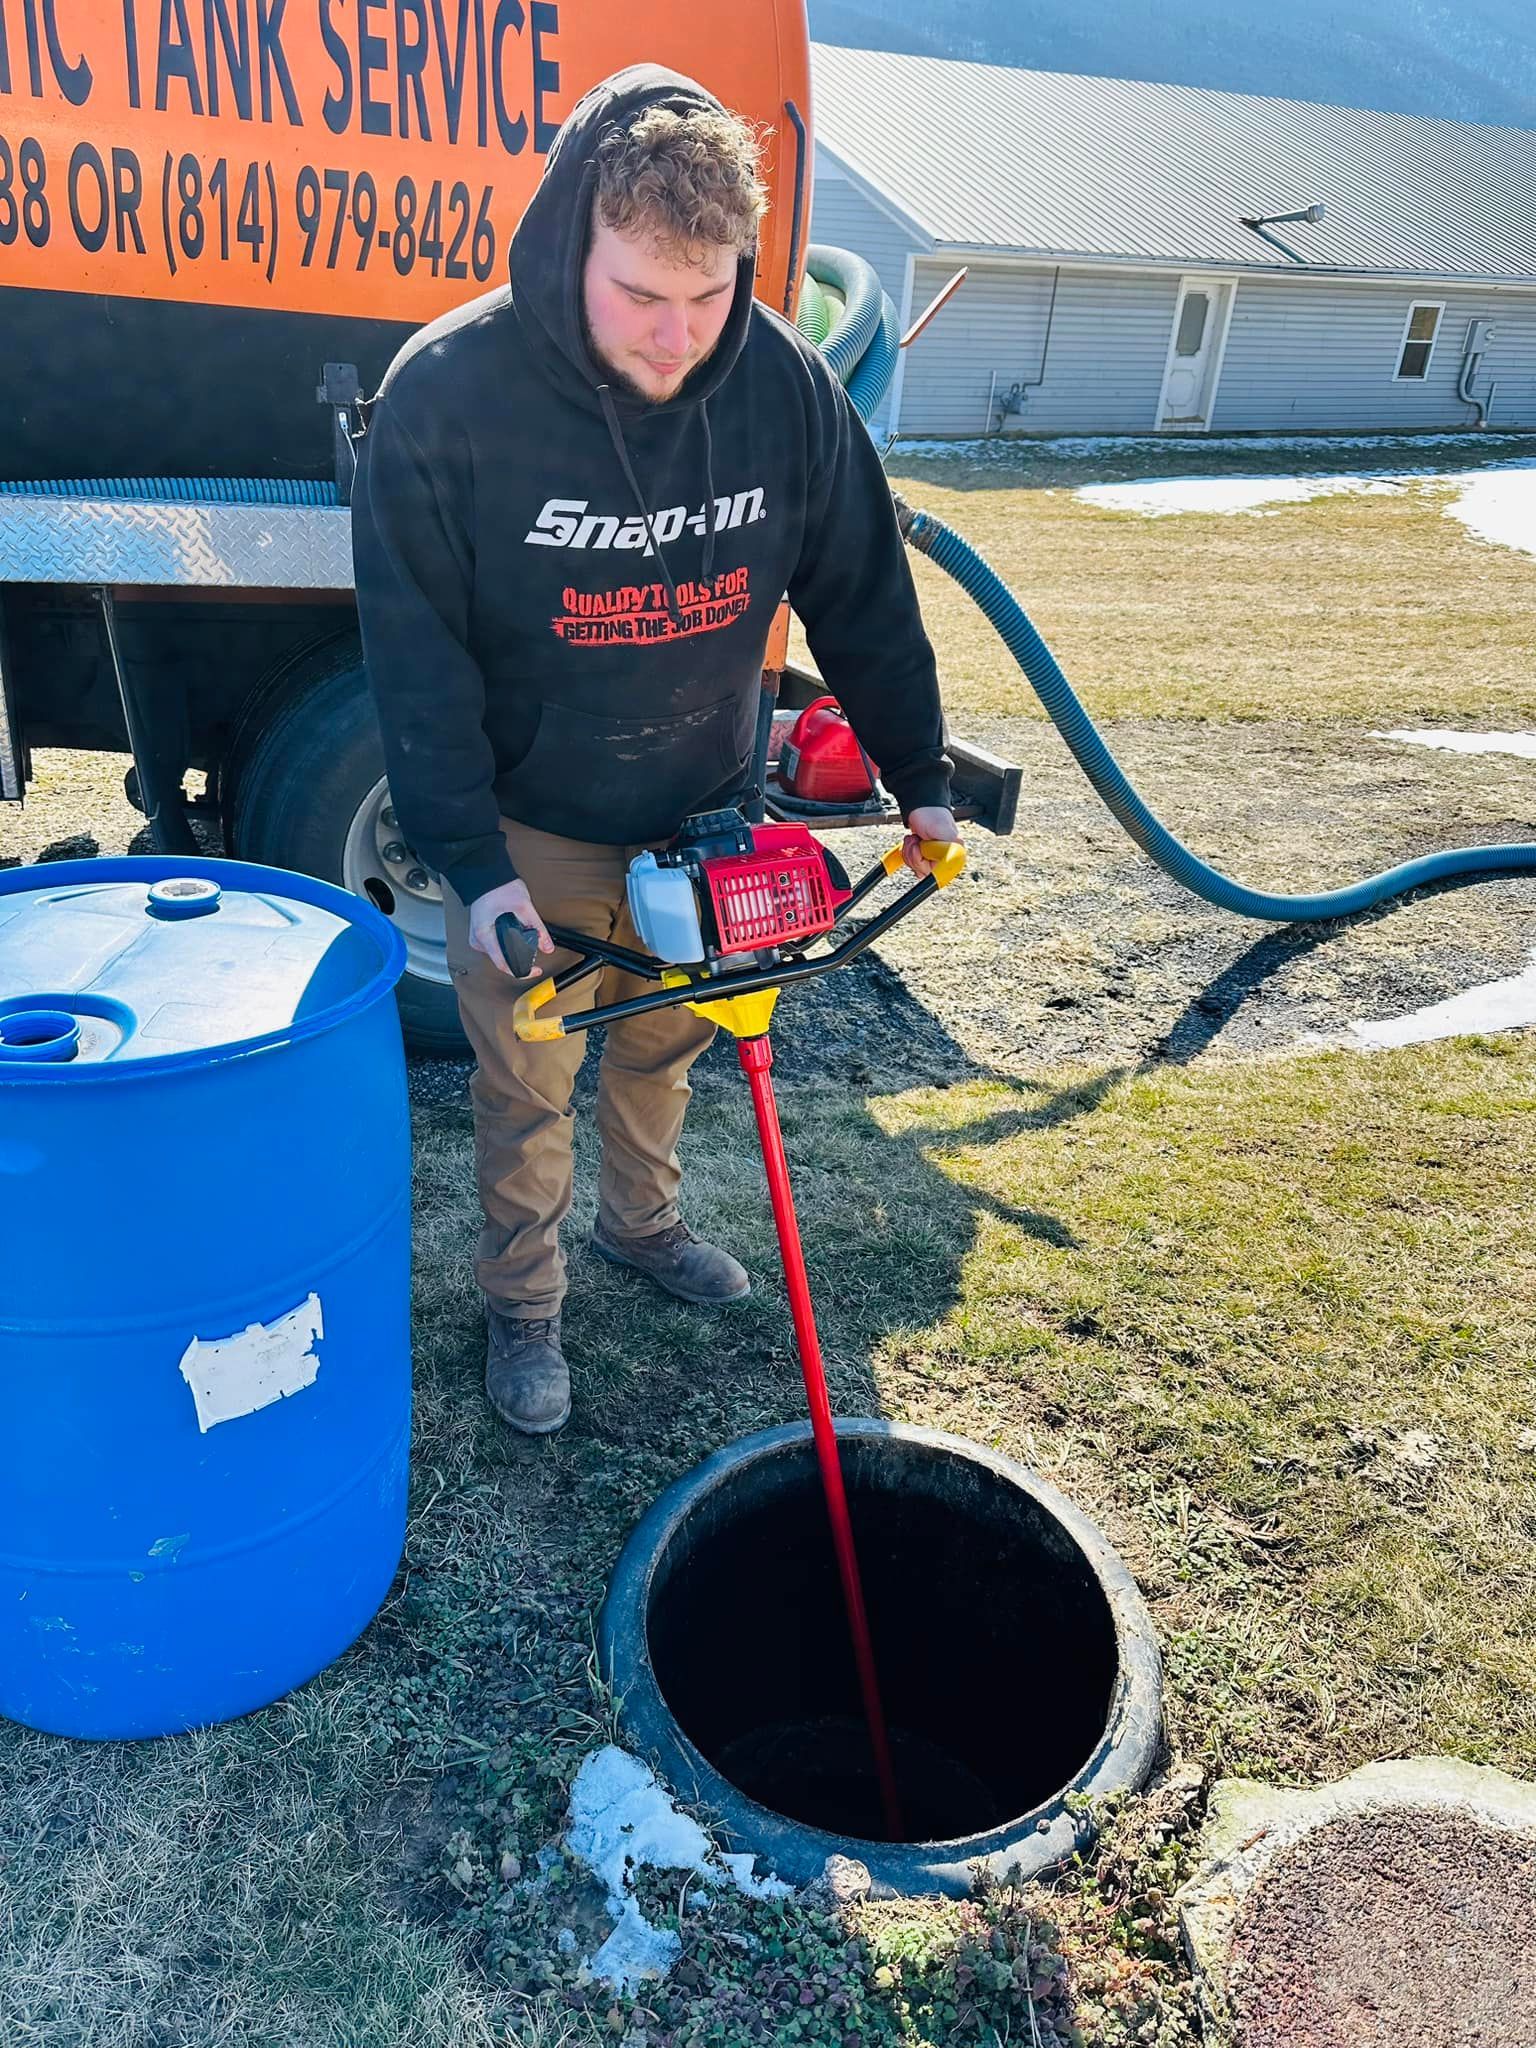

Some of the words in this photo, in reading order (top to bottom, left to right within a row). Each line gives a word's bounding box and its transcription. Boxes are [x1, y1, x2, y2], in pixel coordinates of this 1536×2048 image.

[122, 0, 304, 127] TANK
[318, 0, 560, 156] SERVICE
[68, 141, 147, 254] OR
[162, 150, 279, 282] (814)
[296, 165, 496, 283] 979-8426
[524, 486, 766, 557] Snap-on
[562, 587, 650, 616] QUALITY
[650, 581, 711, 609] TOLS
[714, 566, 749, 597] FOR
[563, 619, 632, 641] GETTING
[634, 616, 667, 638] THE
